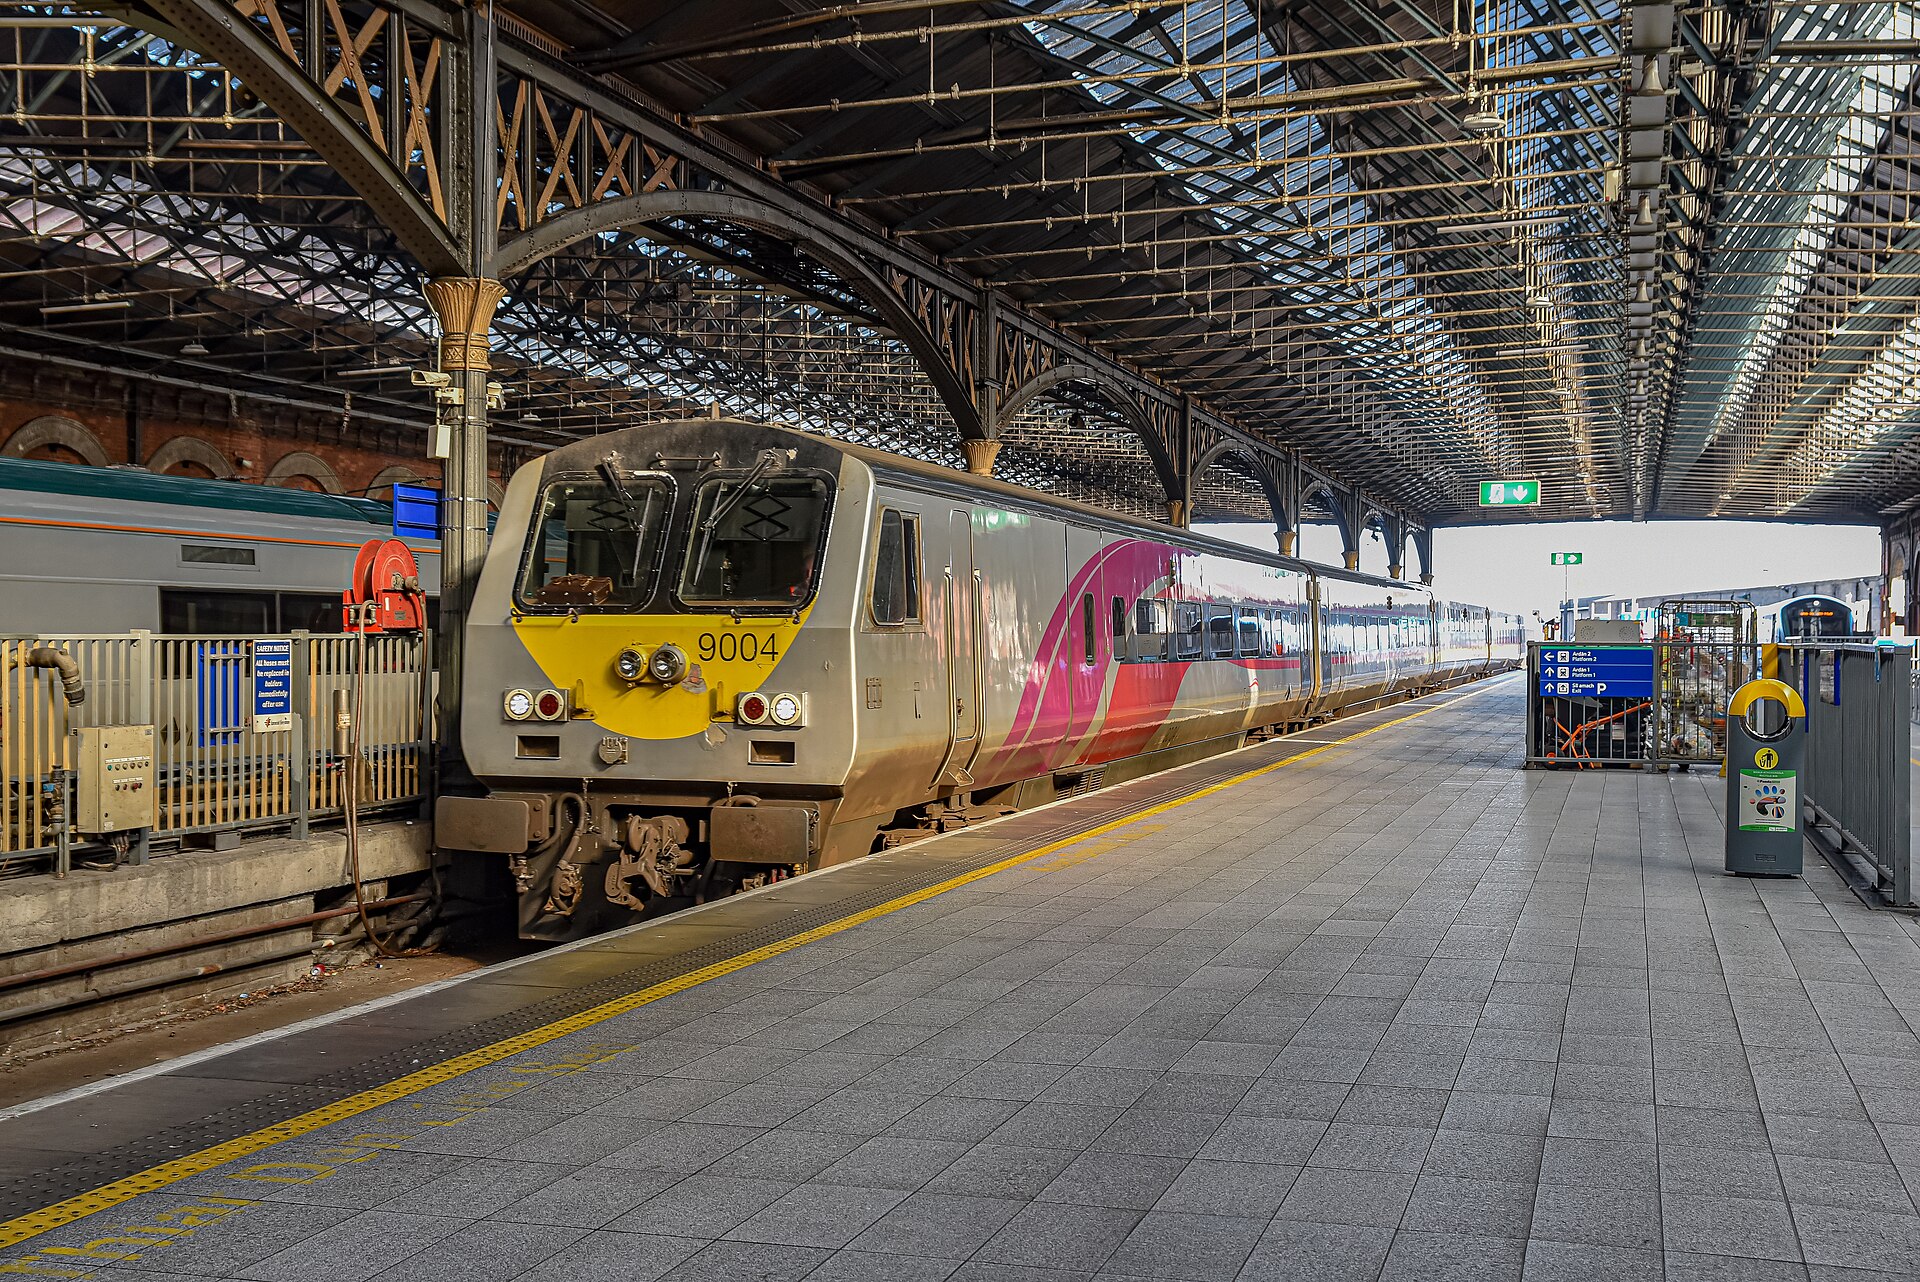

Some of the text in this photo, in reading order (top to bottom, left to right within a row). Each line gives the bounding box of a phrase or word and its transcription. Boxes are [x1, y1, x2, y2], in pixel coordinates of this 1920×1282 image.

[698, 632, 779, 662] 9004
[263, 670, 284, 678] replaced
[258, 690, 288, 698] immediately
